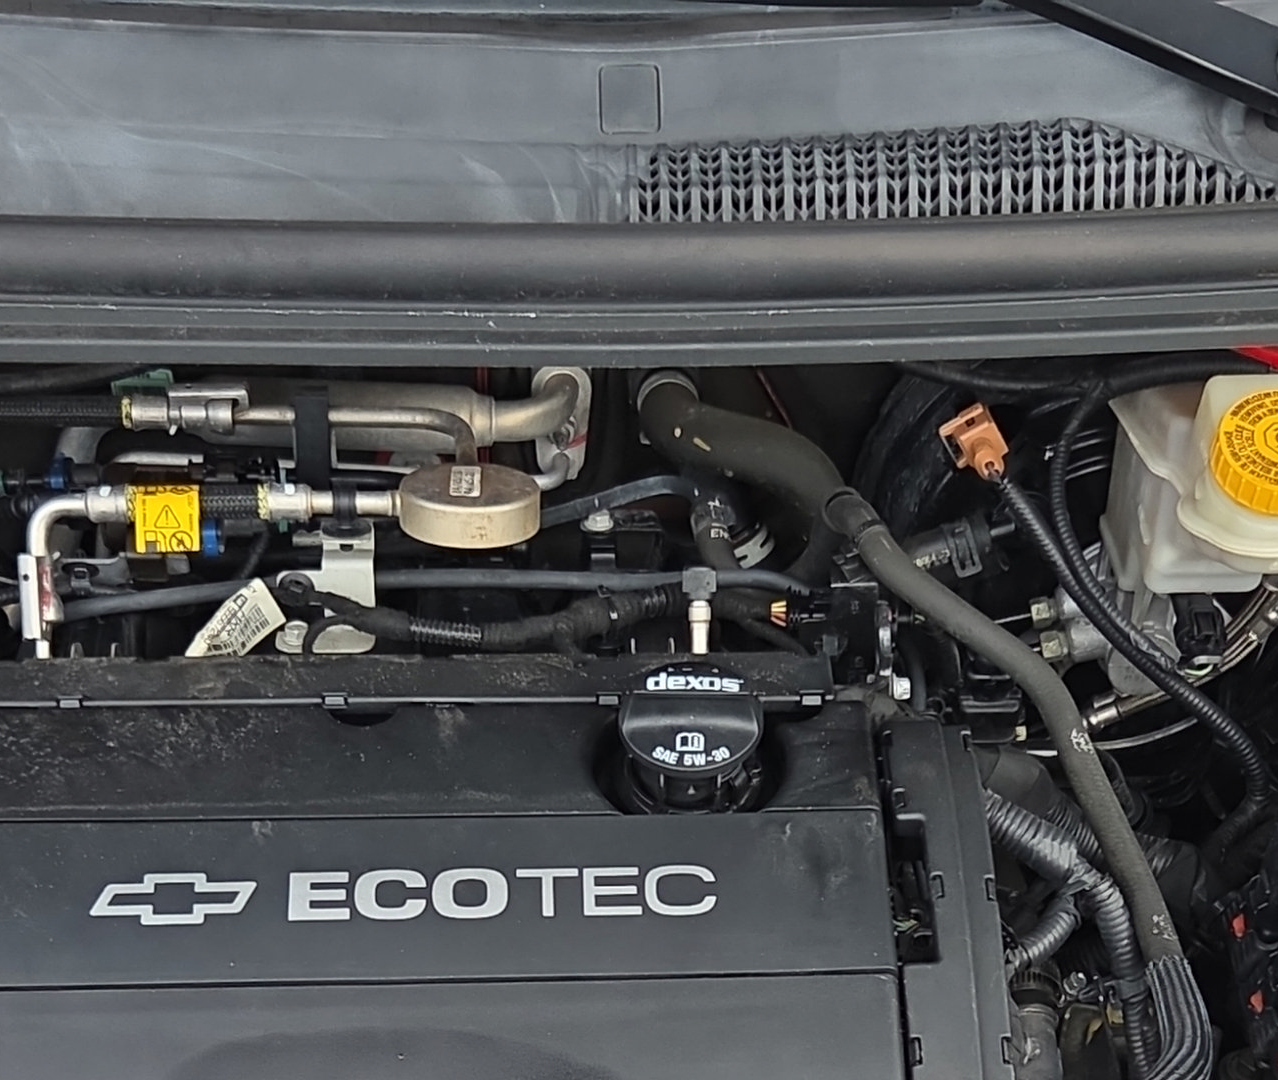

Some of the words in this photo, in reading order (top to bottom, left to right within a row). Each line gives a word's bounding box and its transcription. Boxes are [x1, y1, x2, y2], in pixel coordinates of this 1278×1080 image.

[646, 672, 741, 693] dexos
[652, 746, 679, 765] SAE
[684, 746, 731, 766] 5W-30
[287, 864, 717, 921] ECOTEC
